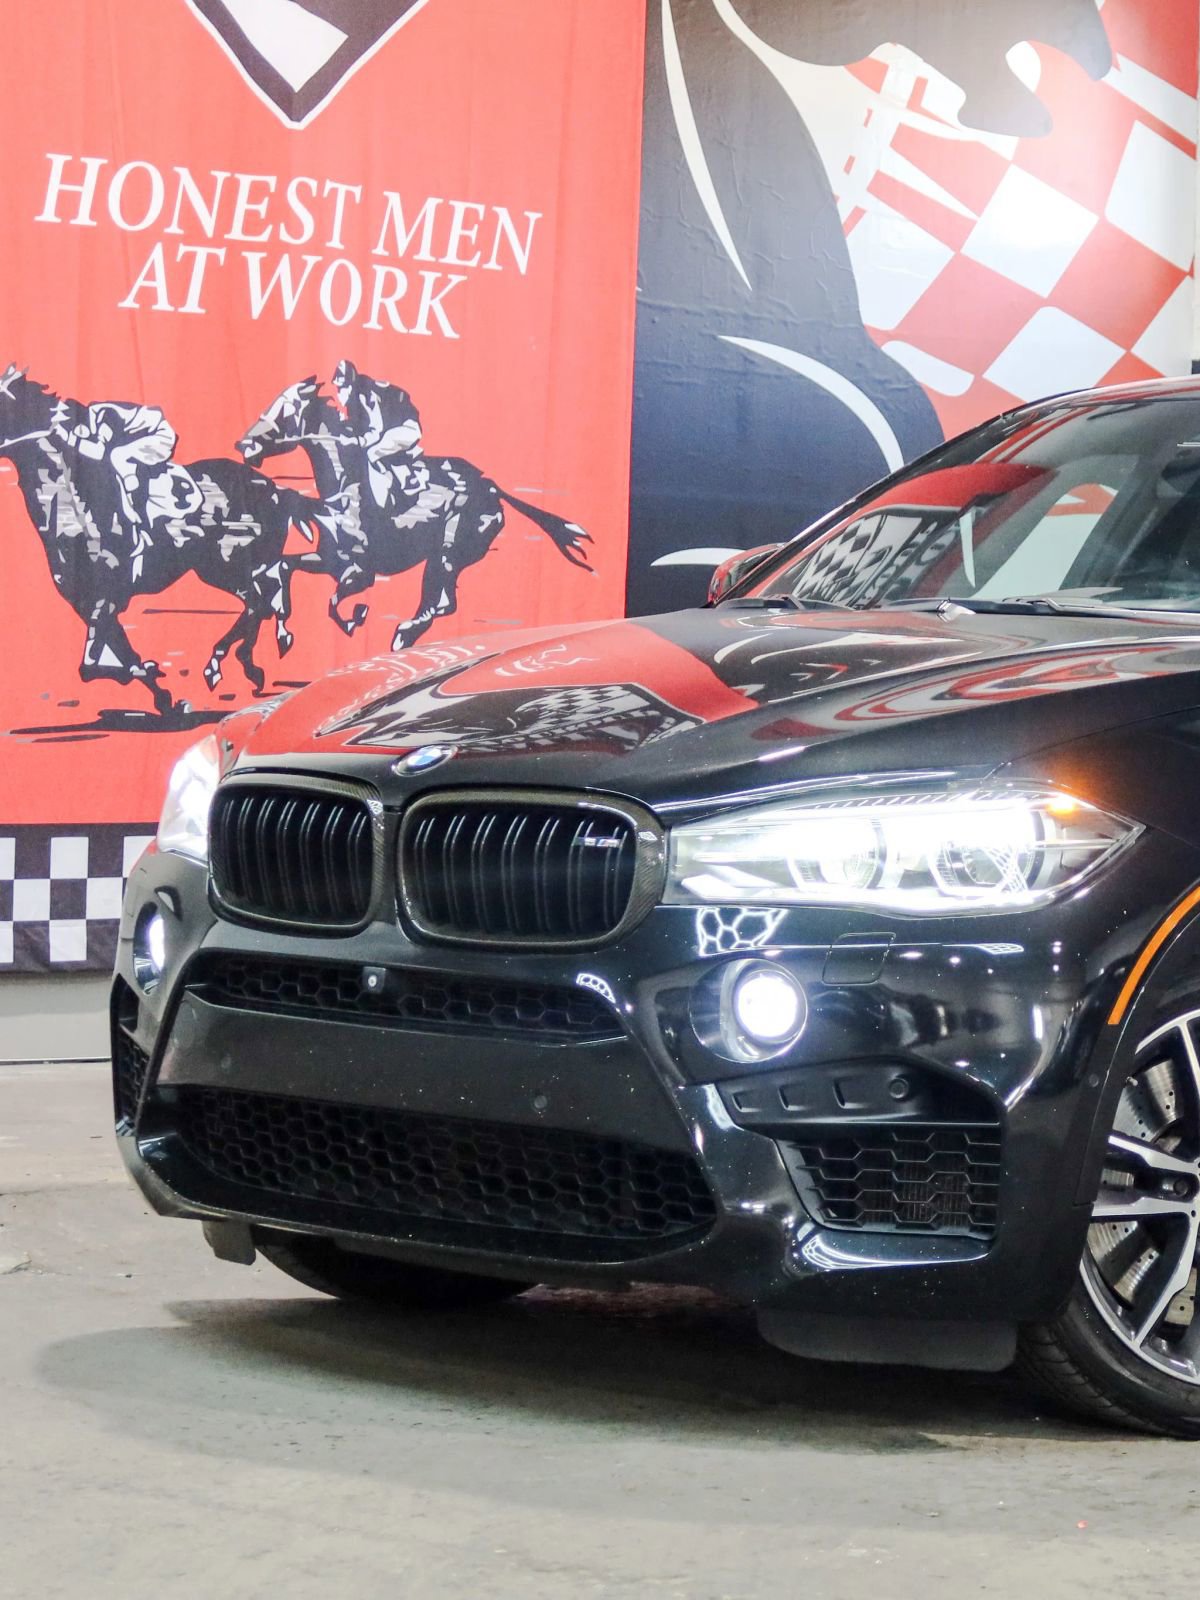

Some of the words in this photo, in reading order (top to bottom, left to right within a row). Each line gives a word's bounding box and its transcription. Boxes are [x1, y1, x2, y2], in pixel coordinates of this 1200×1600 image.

[34, 152, 363, 250] HONEST
[371, 190, 543, 275] MEN
[117, 241, 227, 314] AT
[241, 251, 468, 339] WORK
